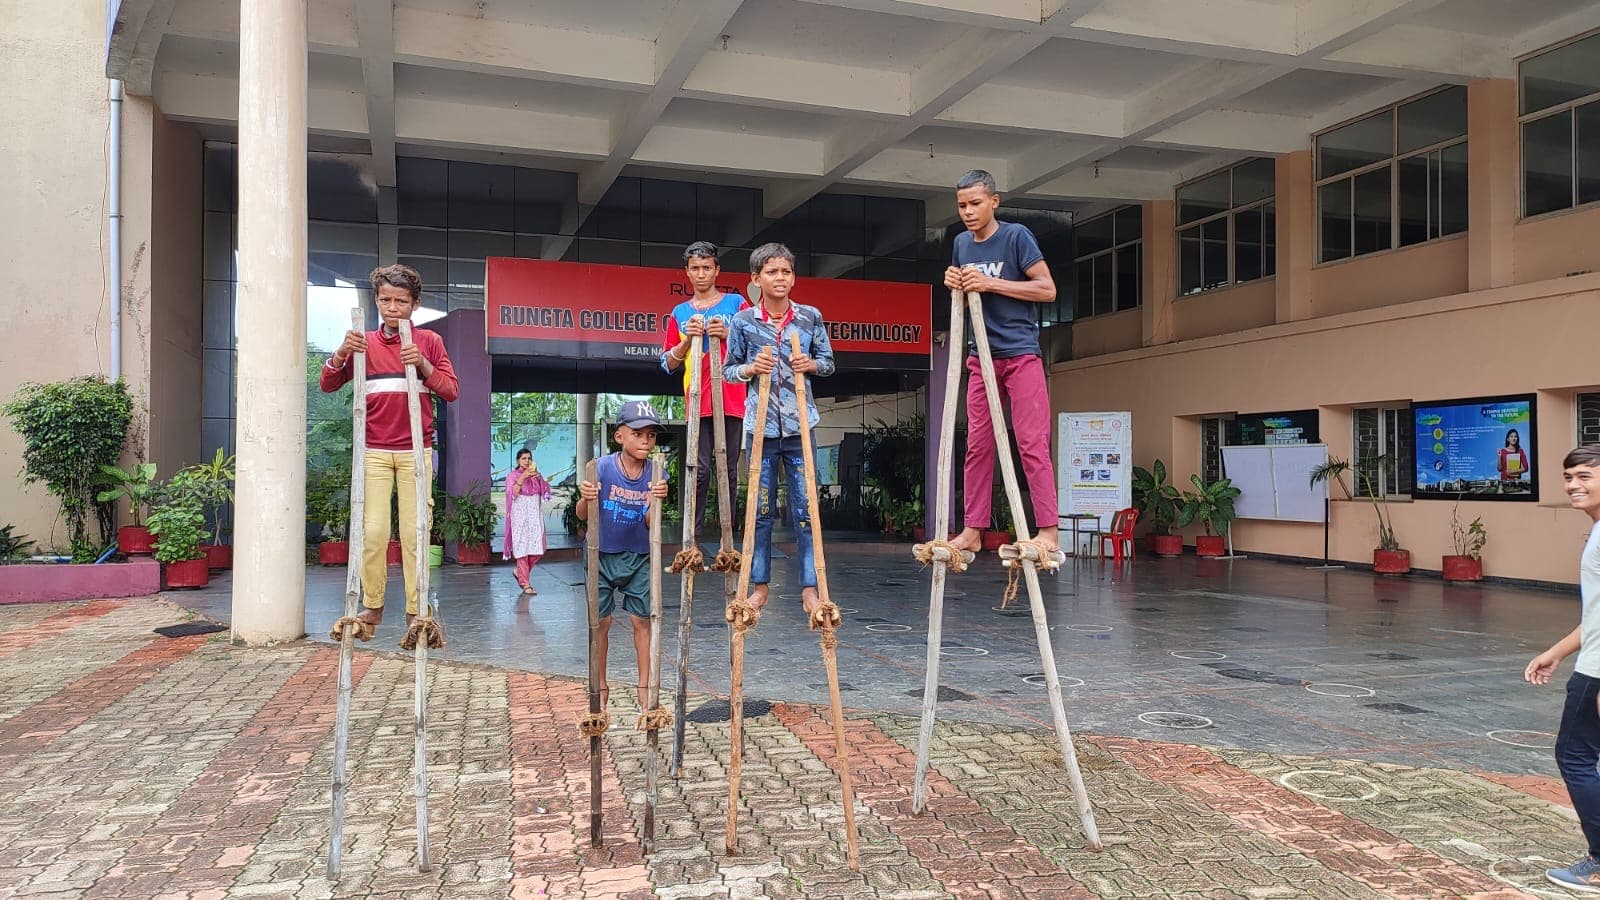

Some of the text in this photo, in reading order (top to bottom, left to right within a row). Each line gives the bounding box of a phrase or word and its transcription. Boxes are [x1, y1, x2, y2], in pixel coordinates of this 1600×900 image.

[670, 283, 741, 296] RUTA
[499, 304, 575, 329] RUNGTA
[580, 309, 657, 332] COLLEGE
[823, 320, 922, 343] TECHNOLOGY
[624, 346, 662, 357] NEAR NA
